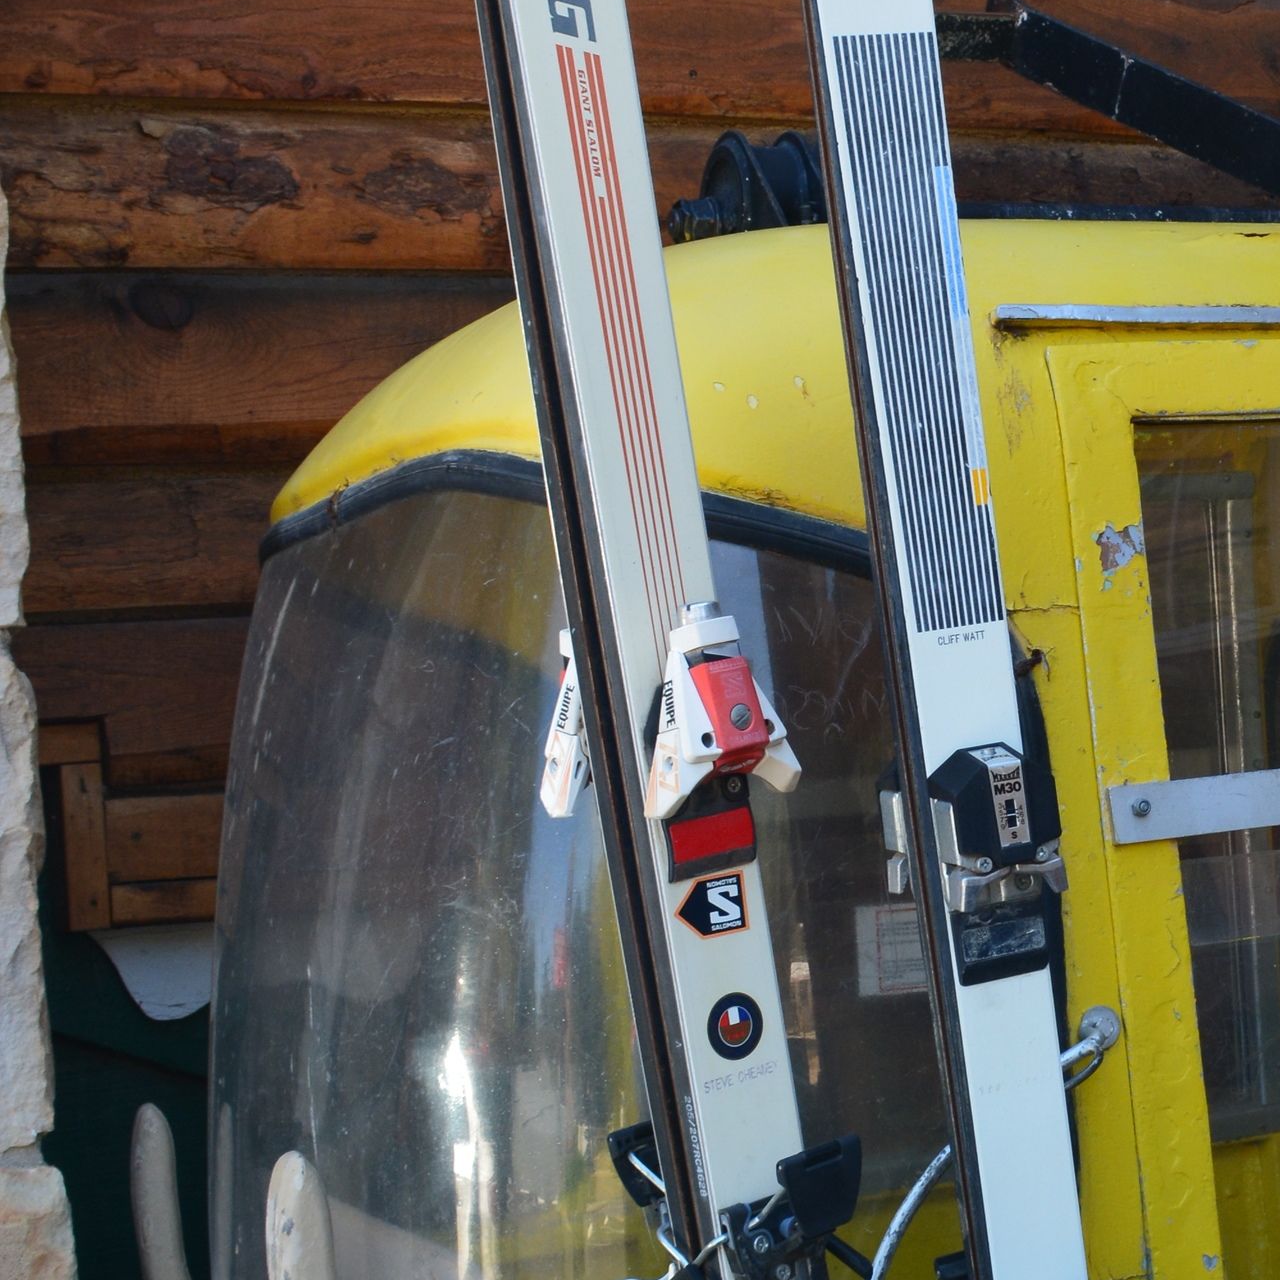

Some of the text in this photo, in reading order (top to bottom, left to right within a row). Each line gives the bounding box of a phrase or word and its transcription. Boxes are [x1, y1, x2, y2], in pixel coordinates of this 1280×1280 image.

[578, 69, 602, 178] GIANT SLALOM
[937, 630, 985, 646] CLIFF WATT
[556, 683, 576, 729] EQUIPE
[663, 679, 677, 729] EQUIPE
[994, 781, 1022, 796] M30
[1011, 831, 1018, 840] S
[706, 876, 737, 889] SALOMON
[711, 919, 742, 932] SALOMON
[704, 1073, 734, 1094] STEVE
